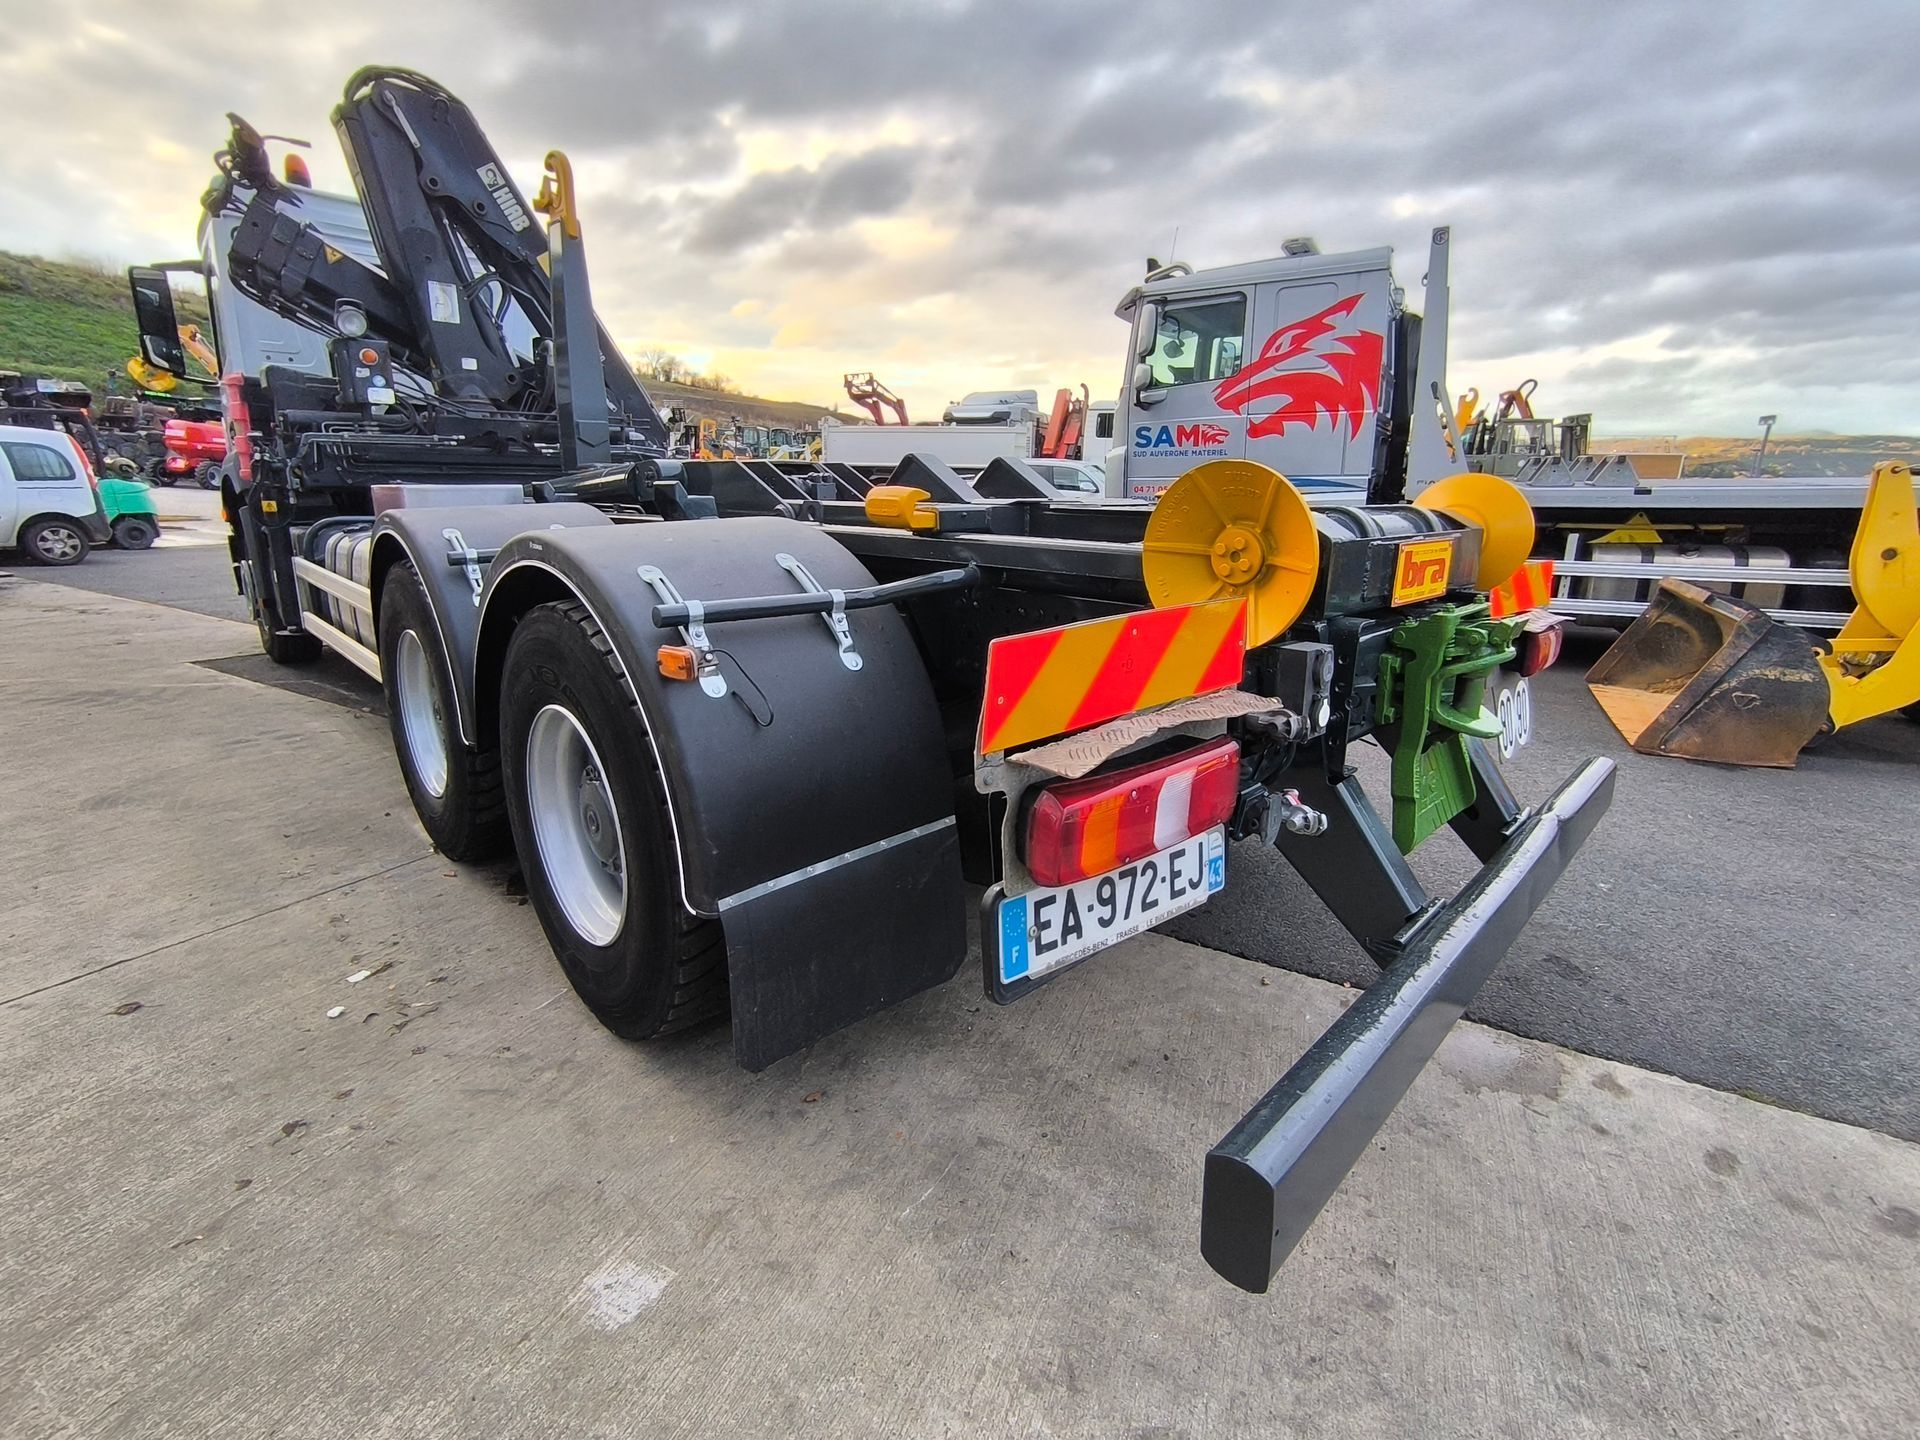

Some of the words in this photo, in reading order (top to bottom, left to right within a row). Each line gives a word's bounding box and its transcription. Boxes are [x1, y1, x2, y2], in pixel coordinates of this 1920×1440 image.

[492, 187, 531, 232] HIAB
[1134, 424, 1201, 448] SAM
[1132, 450, 1148, 458] SUD
[1149, 449, 1189, 457] AUVERGNE
[1191, 448, 1229, 457] MATERIEL
[1133, 485, 1144, 493] 04
[1400, 550, 1446, 590] bra
[1209, 859, 1223, 885] 43
[1116, 925, 1140, 941] FRAISSE
[1011, 944, 1020, 964] F
